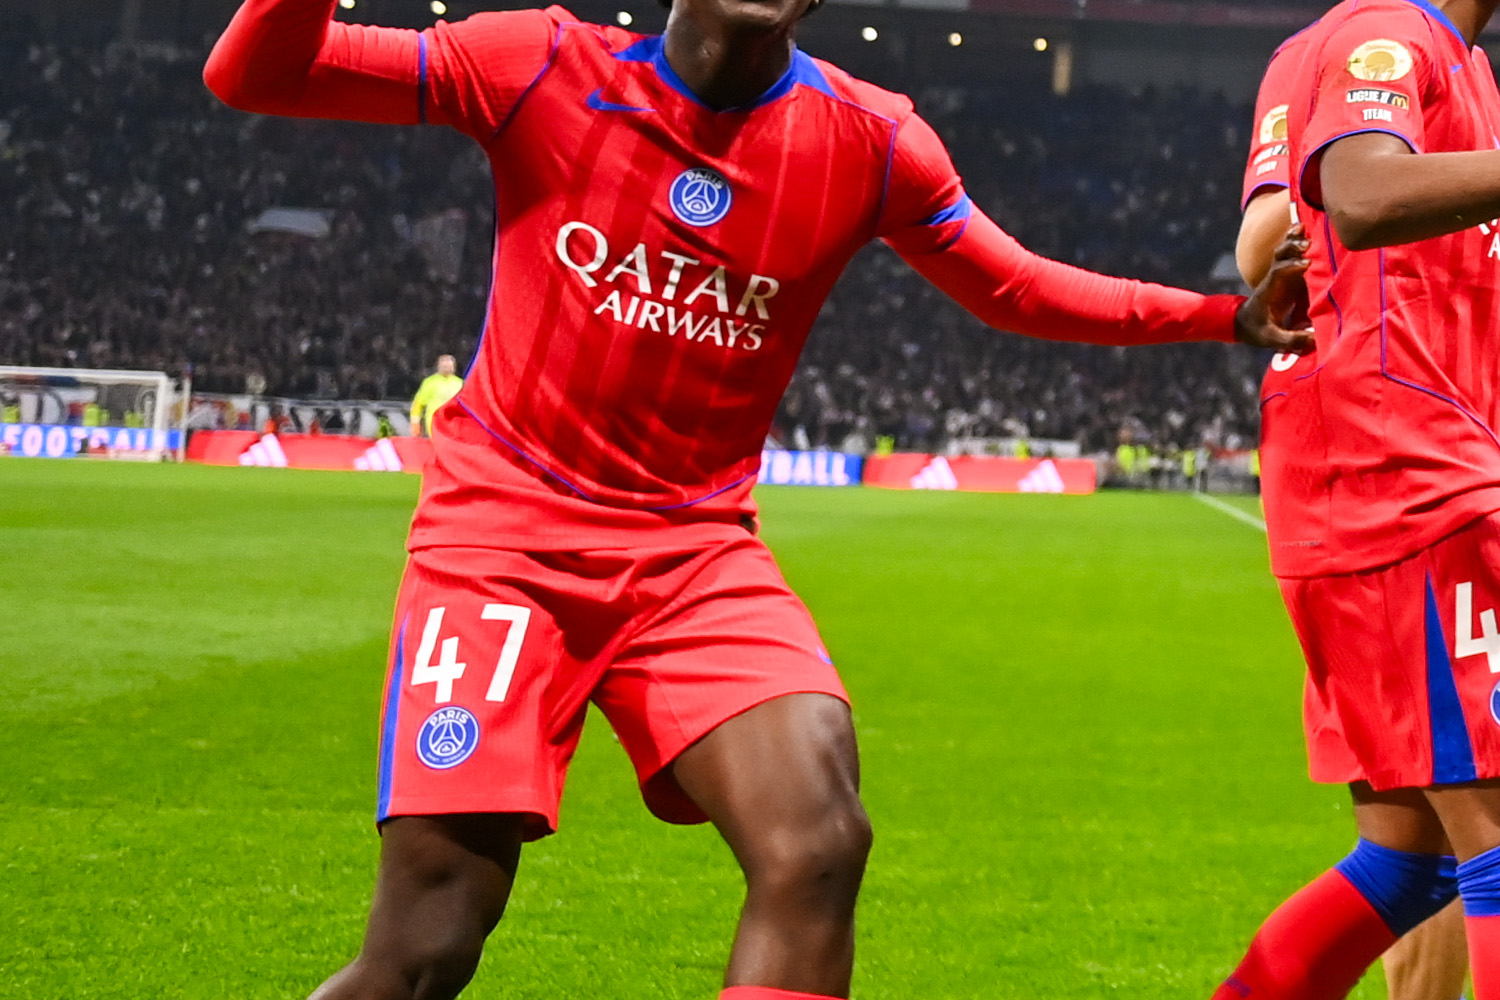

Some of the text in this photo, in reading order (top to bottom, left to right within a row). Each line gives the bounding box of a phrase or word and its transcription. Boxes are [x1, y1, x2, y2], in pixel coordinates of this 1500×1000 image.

[685, 170, 725, 190] PARIS
[556, 221, 779, 320] QATAR
[594, 290, 766, 350] AIRWAYS
[411, 603, 531, 704] 47
[429, 710, 469, 727] PARIS
